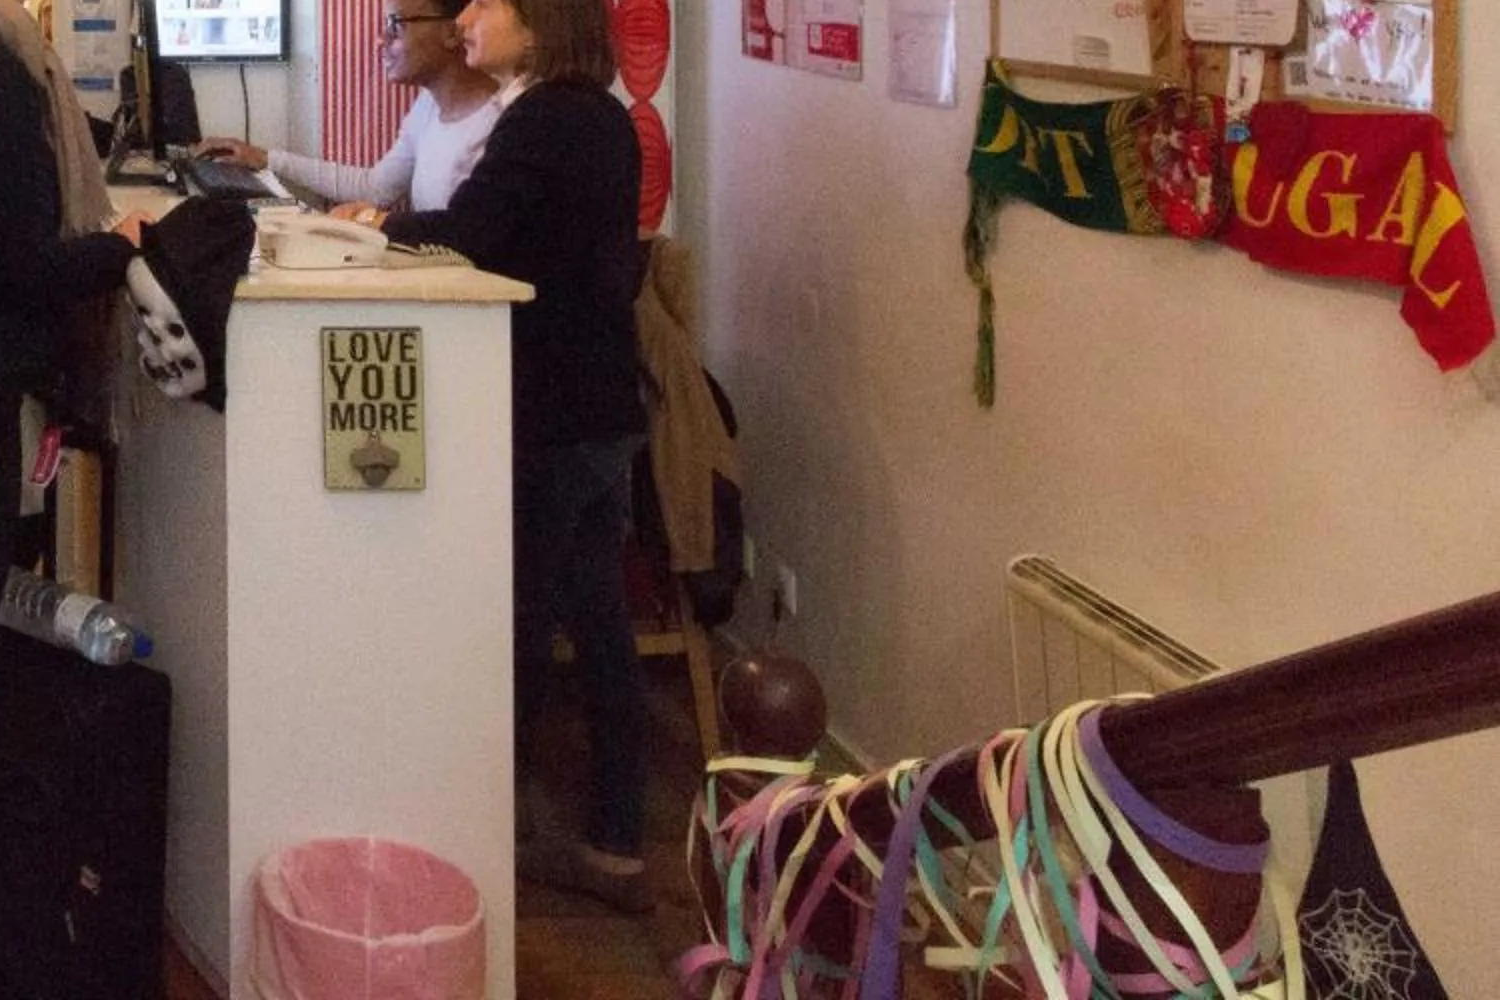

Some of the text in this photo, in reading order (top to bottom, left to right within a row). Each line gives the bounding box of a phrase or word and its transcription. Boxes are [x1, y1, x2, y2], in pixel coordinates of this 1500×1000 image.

[329, 332, 418, 362] LOVE
[328, 363, 418, 401] YOU
[330, 401, 419, 432] MORE
